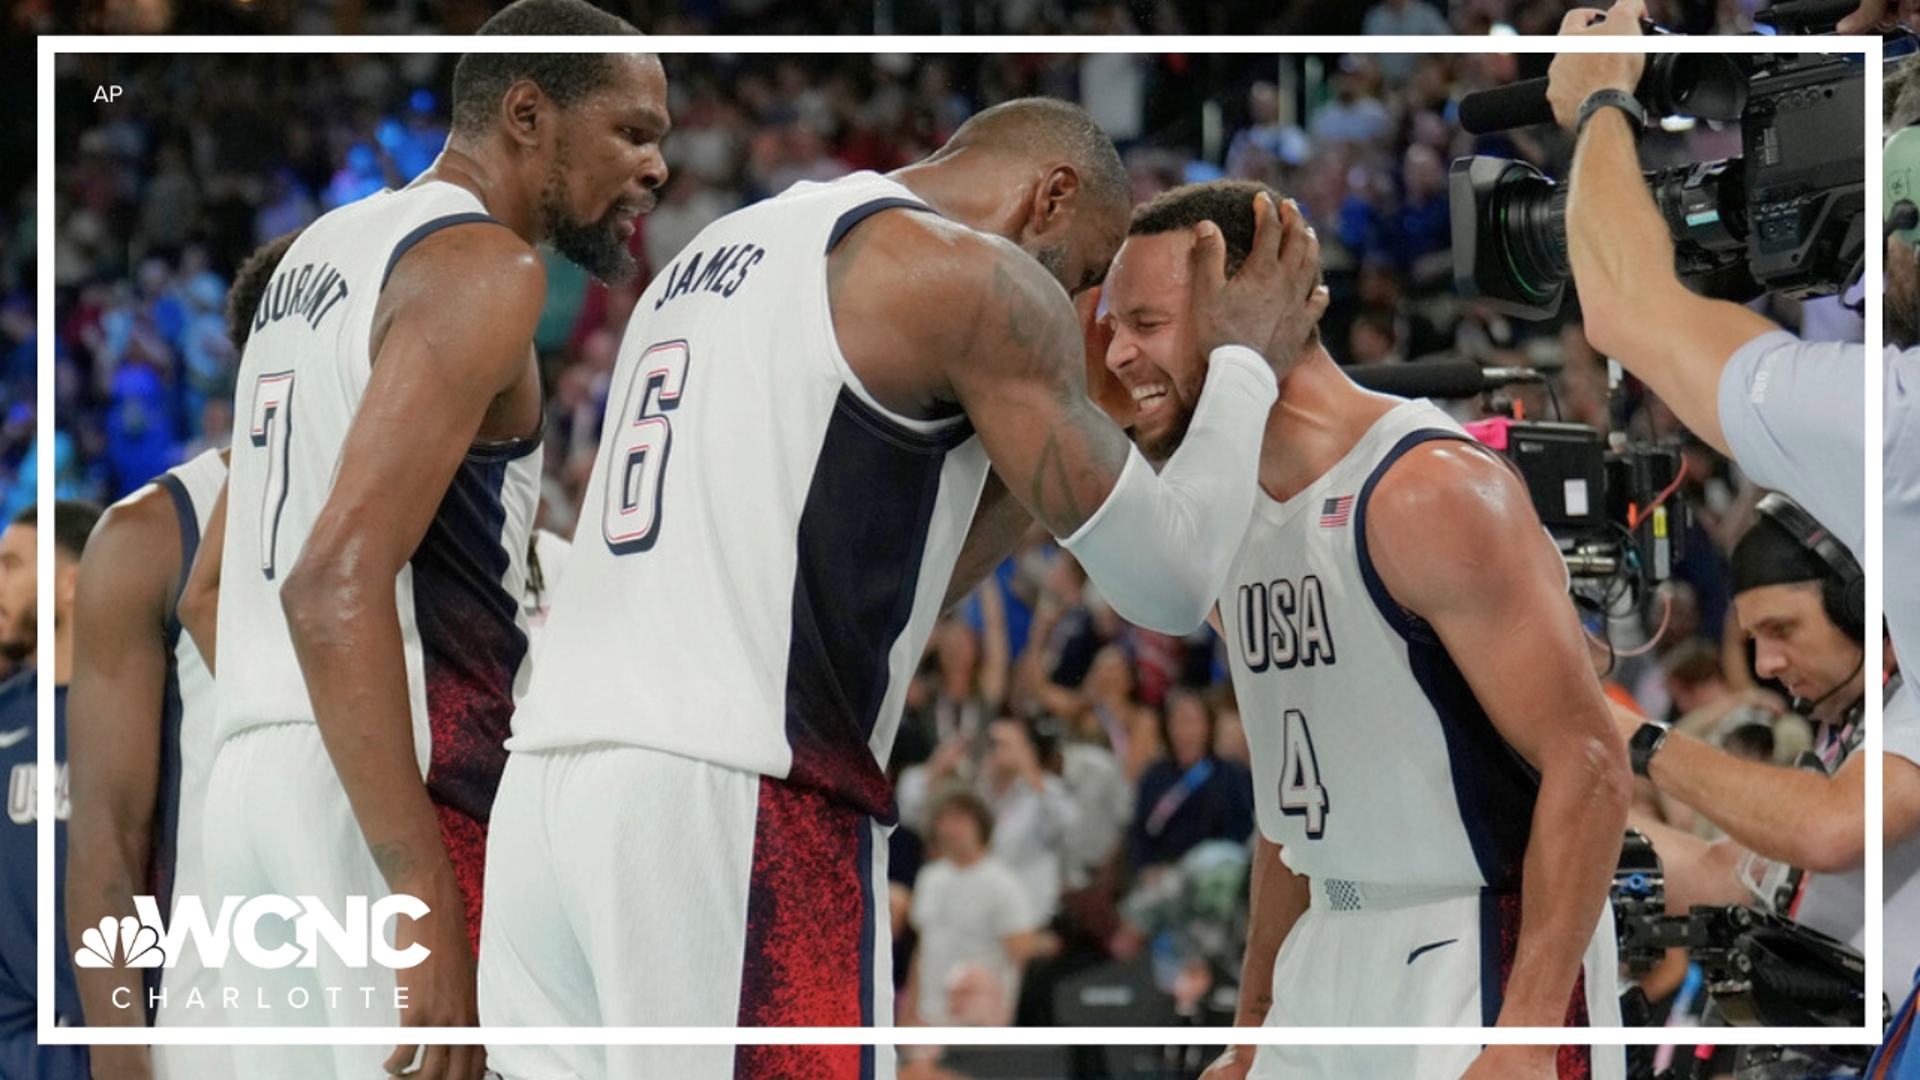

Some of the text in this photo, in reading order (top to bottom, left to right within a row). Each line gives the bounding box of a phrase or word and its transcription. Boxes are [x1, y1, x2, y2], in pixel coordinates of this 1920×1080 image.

[255, 262, 348, 334] DURANT
[655, 243, 765, 311] JAMES
[251, 369, 295, 581] 7
[602, 338, 690, 556] 6
[1238, 575, 1336, 673] USA
[1278, 709, 1329, 840] 4
